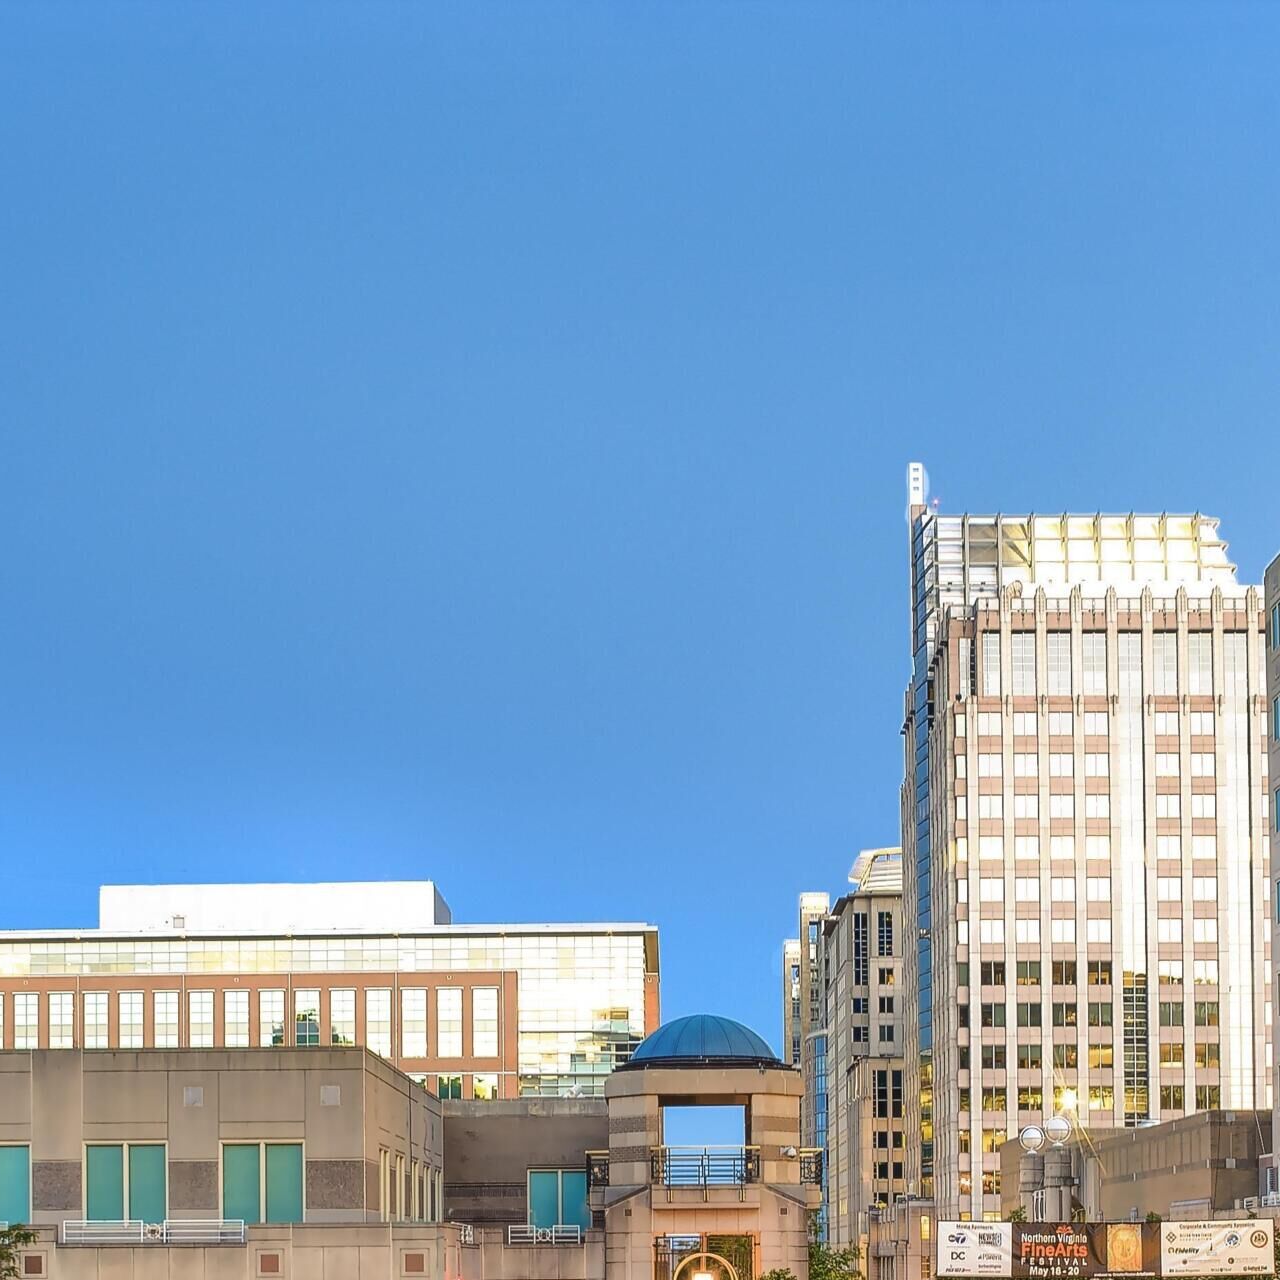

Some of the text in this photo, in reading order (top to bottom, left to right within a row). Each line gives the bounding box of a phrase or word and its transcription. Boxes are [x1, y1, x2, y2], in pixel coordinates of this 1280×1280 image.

[1021, 1233, 1088, 1245] Northern Virginia
[1021, 1242, 1088, 1257] FineArts
[1175, 1247, 1200, 1255] Fidelity
[951, 1251, 966, 1260] DC
[1021, 1257, 1088, 1266] FESTIVAL
[1029, 1266, 1049, 1277] May
[1067, 1266, 1080, 1276] 20
